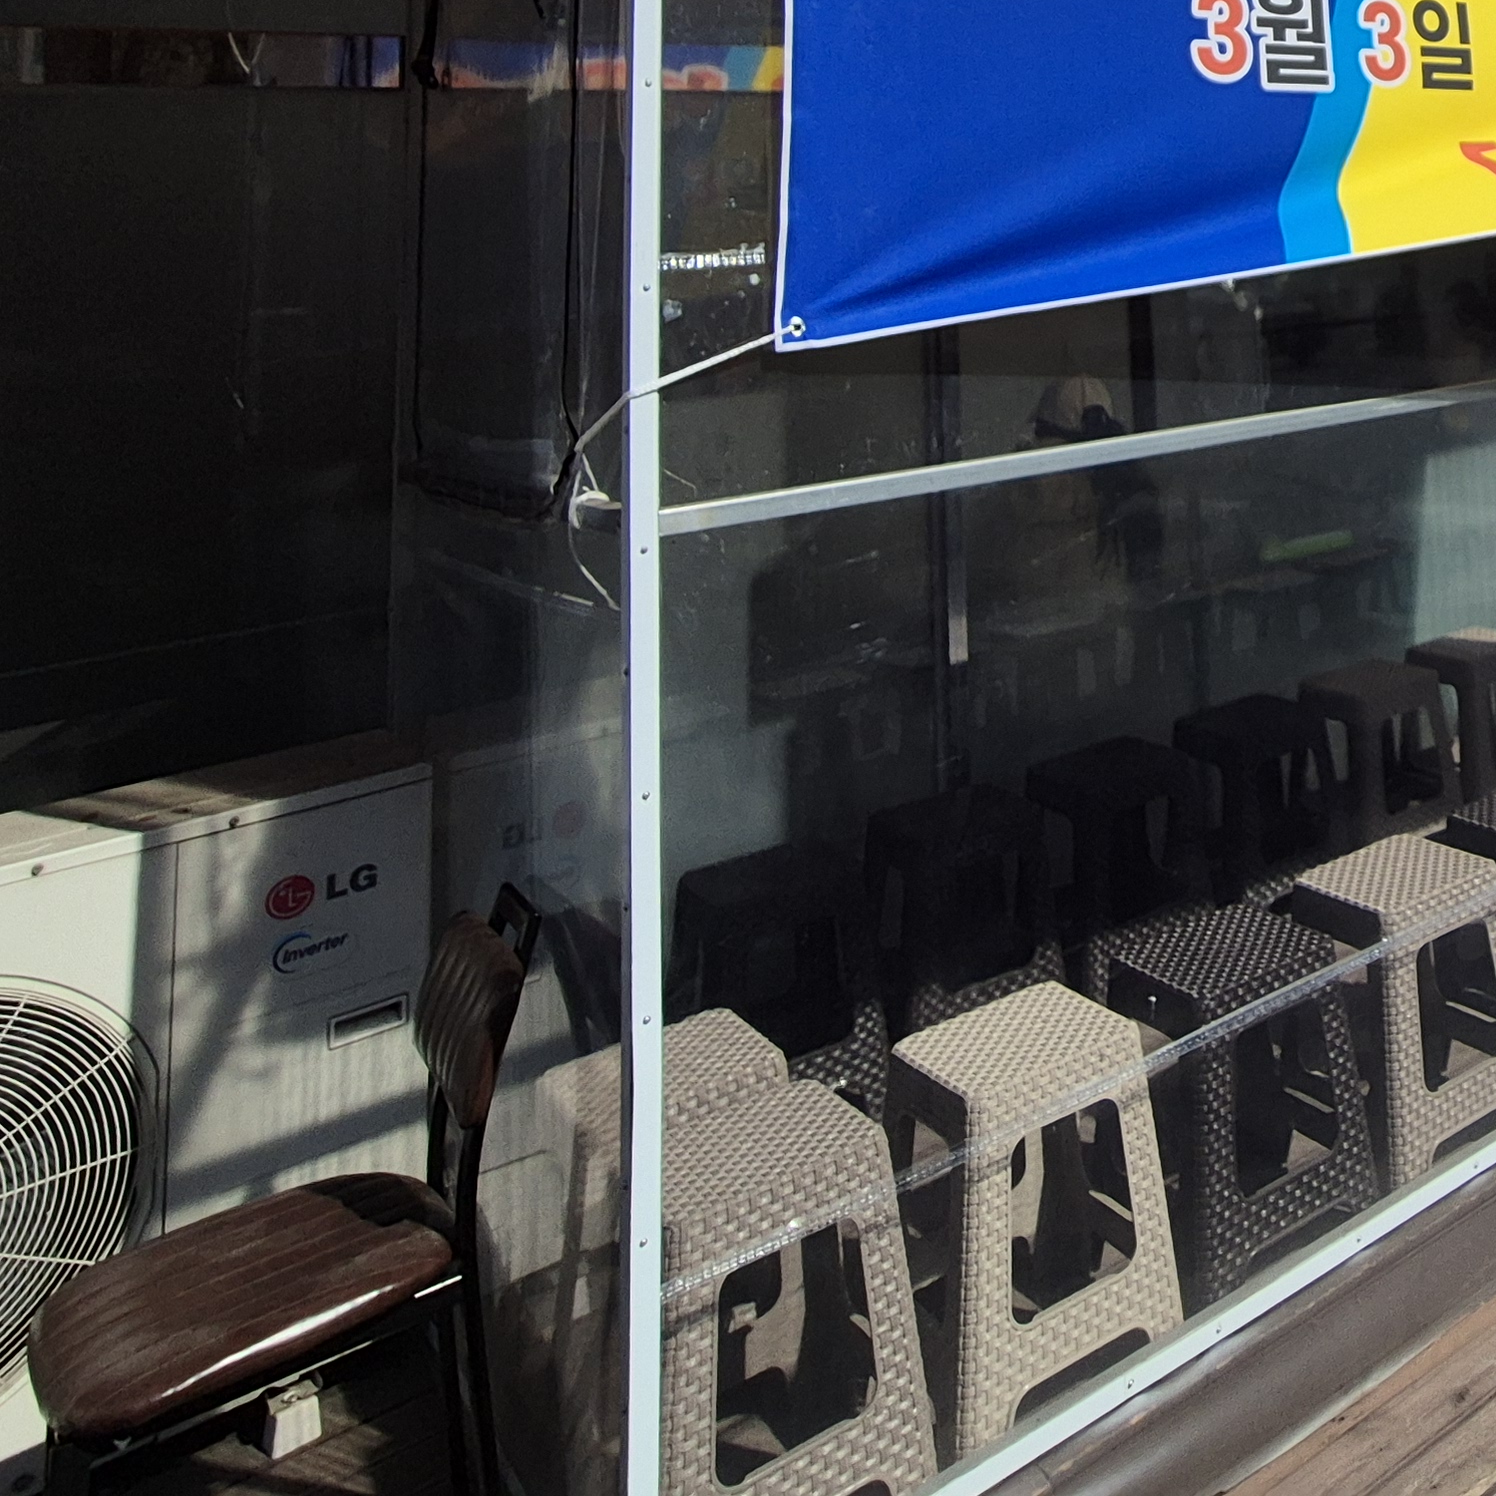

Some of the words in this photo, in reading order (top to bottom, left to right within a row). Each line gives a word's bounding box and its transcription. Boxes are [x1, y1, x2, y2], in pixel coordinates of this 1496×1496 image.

[1362, 0, 1474, 91] 3일
[326, 863, 378, 900] LG
[282, 933, 349, 965] Inverter
